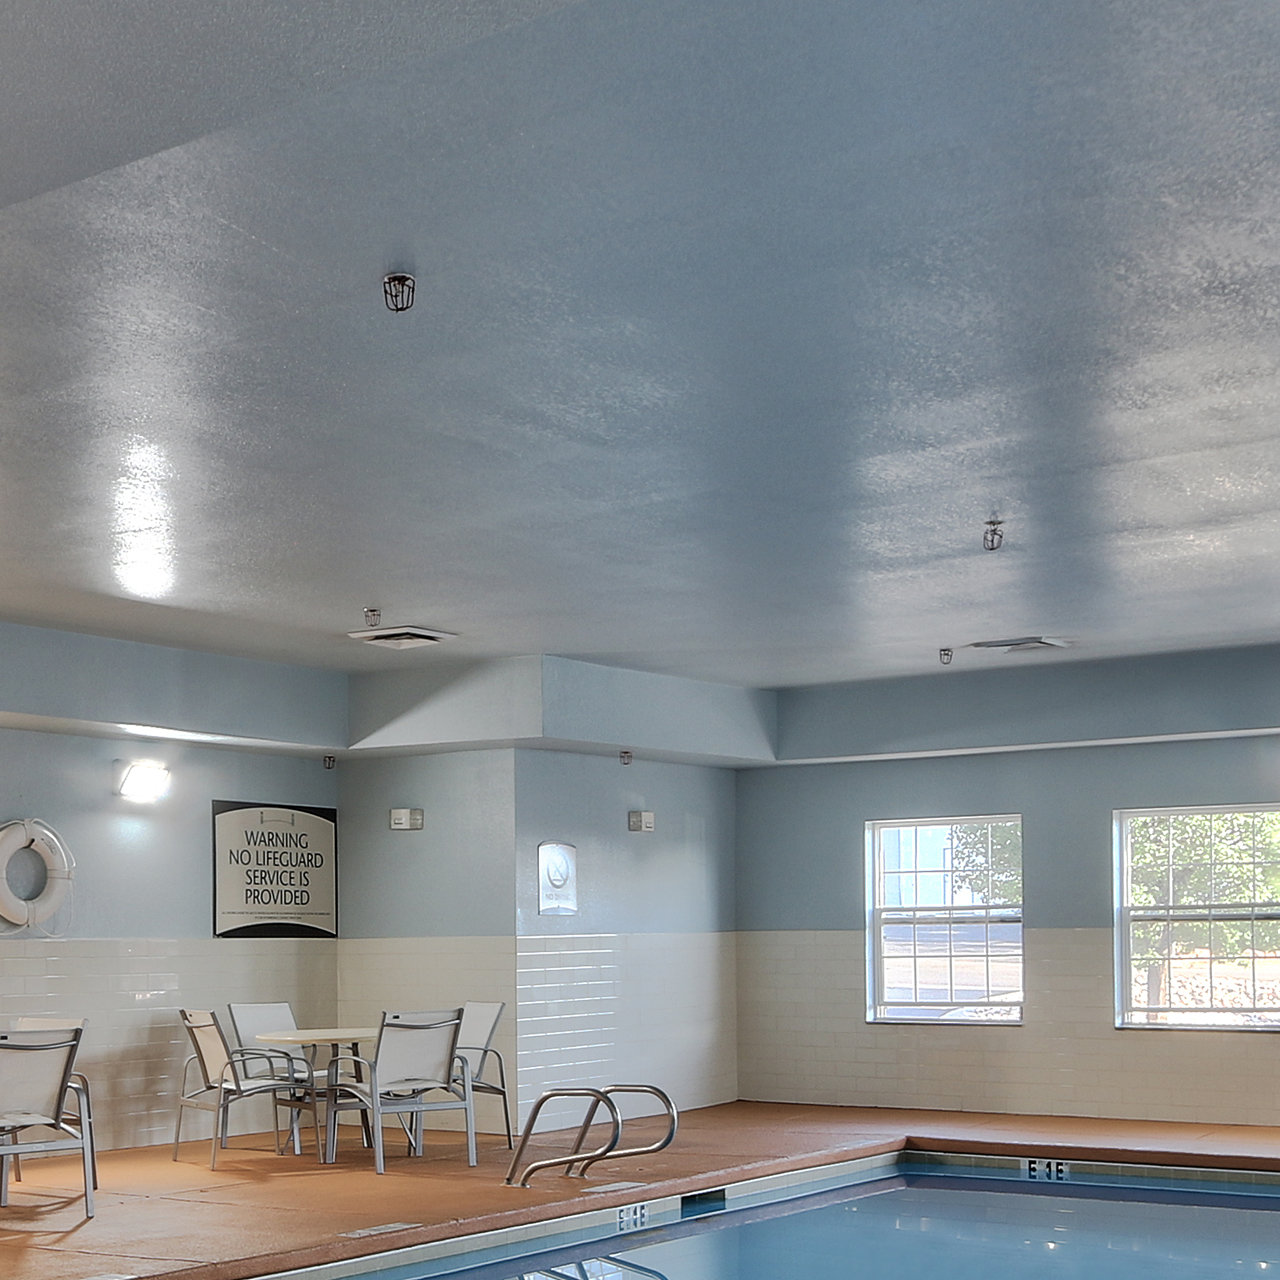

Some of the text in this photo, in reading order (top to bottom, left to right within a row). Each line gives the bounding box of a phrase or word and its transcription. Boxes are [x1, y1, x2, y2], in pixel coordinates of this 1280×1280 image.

[245, 830, 308, 849] WARNING
[229, 849, 324, 868] NO LIFEGUARD
[245, 869, 310, 887] SERVICE IS
[245, 888, 311, 906] PROVIDED
